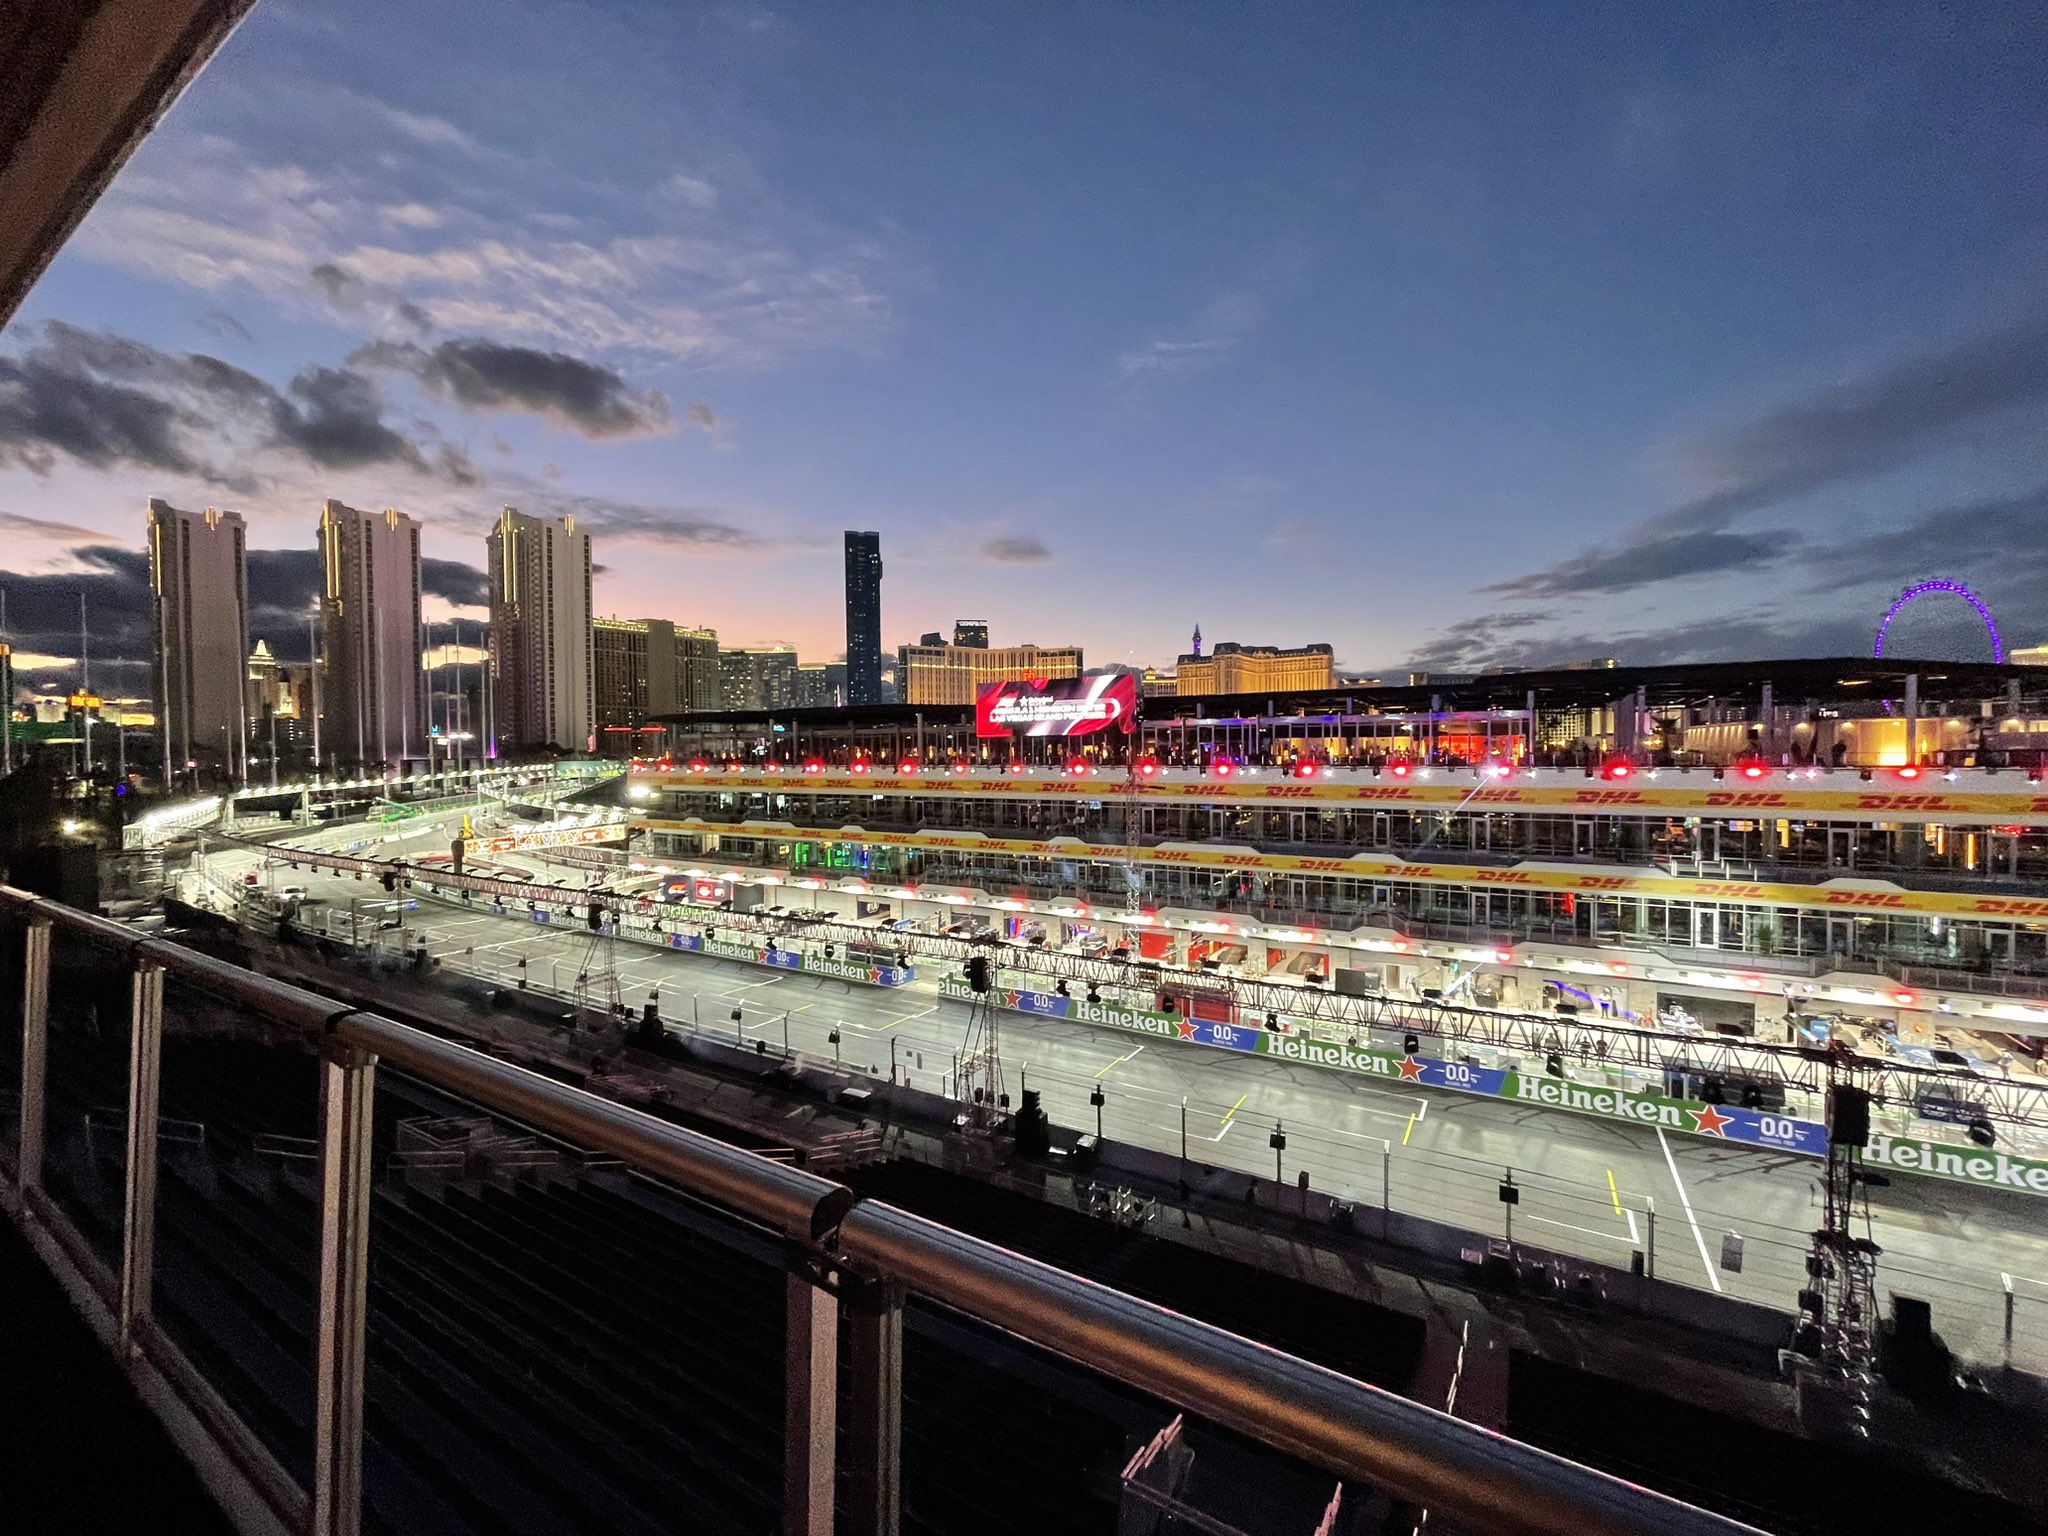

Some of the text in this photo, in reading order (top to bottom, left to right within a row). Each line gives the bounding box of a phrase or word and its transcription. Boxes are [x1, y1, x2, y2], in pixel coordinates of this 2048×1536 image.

[826, 780, 851, 788] DHL
[874, 780, 900, 788] DHL
[925, 781, 954, 790] DHL
[981, 782, 1013, 791] DHL
[1042, 783, 1078, 792] DHL
[1183, 785, 1227, 795] DHL
[1265, 786, 1315, 798] DHL
[1358, 788, 1413, 799] DHL
[1459, 789, 1523, 802] DHL
[1575, 791, 1645, 804] DHL
[1705, 793, 1788, 807] DHL
[1856, 795, 1950, 811] DHL
[840, 832, 864, 840] DHL
[883, 834, 909, 843] DHL
[929, 837, 956, 846] DHL
[977, 840, 1008, 850] DHL
[1032, 843, 1064, 853] DHL
[571, 848, 603, 862] AIRWAYS
[1090, 847, 1124, 857] DHL
[1153, 850, 1191, 861] DHL
[1223, 855, 1265, 866] DHL
[1300, 860, 1344, 871] DHL
[1384, 864, 1433, 877] DHL
[1476, 870, 1532, 883] DHL
[1578, 876, 1641, 890] DHL
[1694, 883, 1766, 898] DHL
[1825, 891, 1906, 908] DHL
[619, 925, 663, 943] Heineken
[704, 939, 755, 961] Heineken
[804, 956, 865, 980] Heineken
[1076, 1000, 1171, 1035] Heineken
[1268, 1034, 1390, 1074] Heineken
[1517, 1074, 1682, 1127] Heineken
